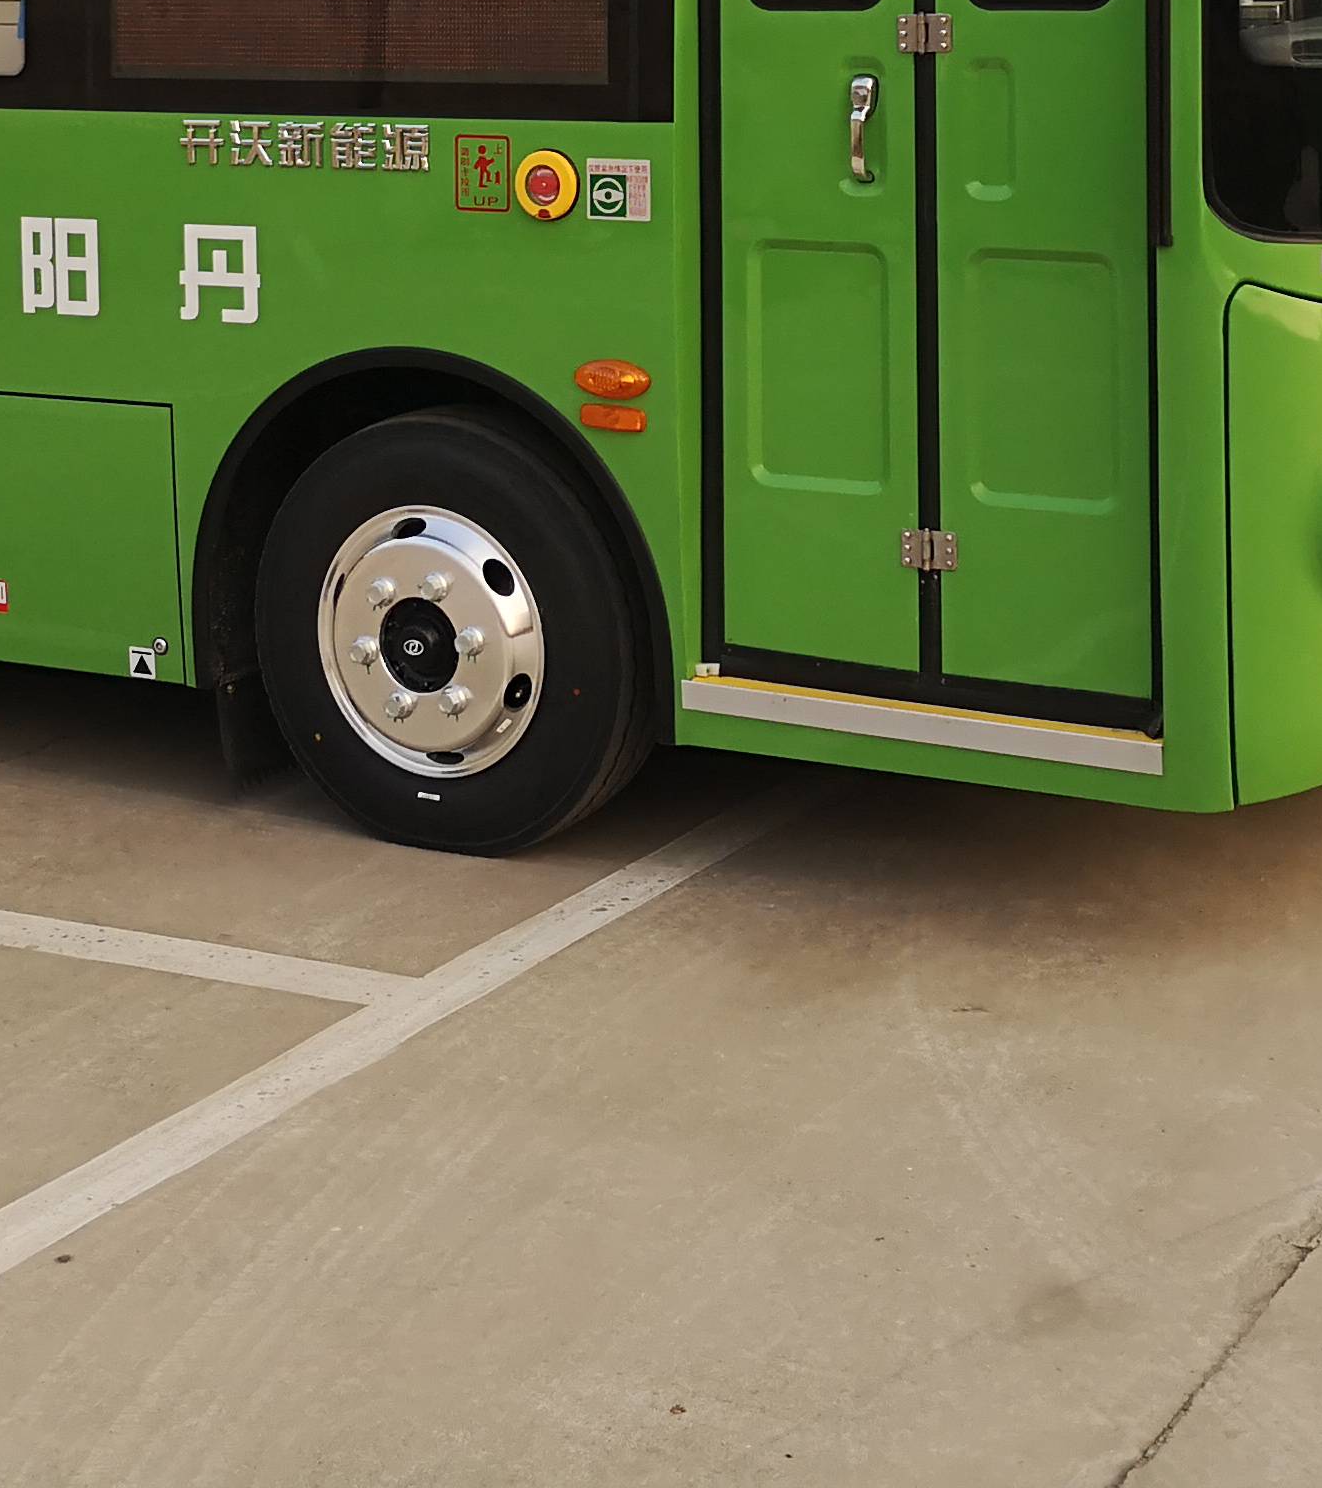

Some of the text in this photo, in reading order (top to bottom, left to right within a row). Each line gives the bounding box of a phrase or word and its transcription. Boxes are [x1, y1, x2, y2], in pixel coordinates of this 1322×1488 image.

[179, 119, 429, 171] 开沃新能源
[474, 196, 499, 206] UP
